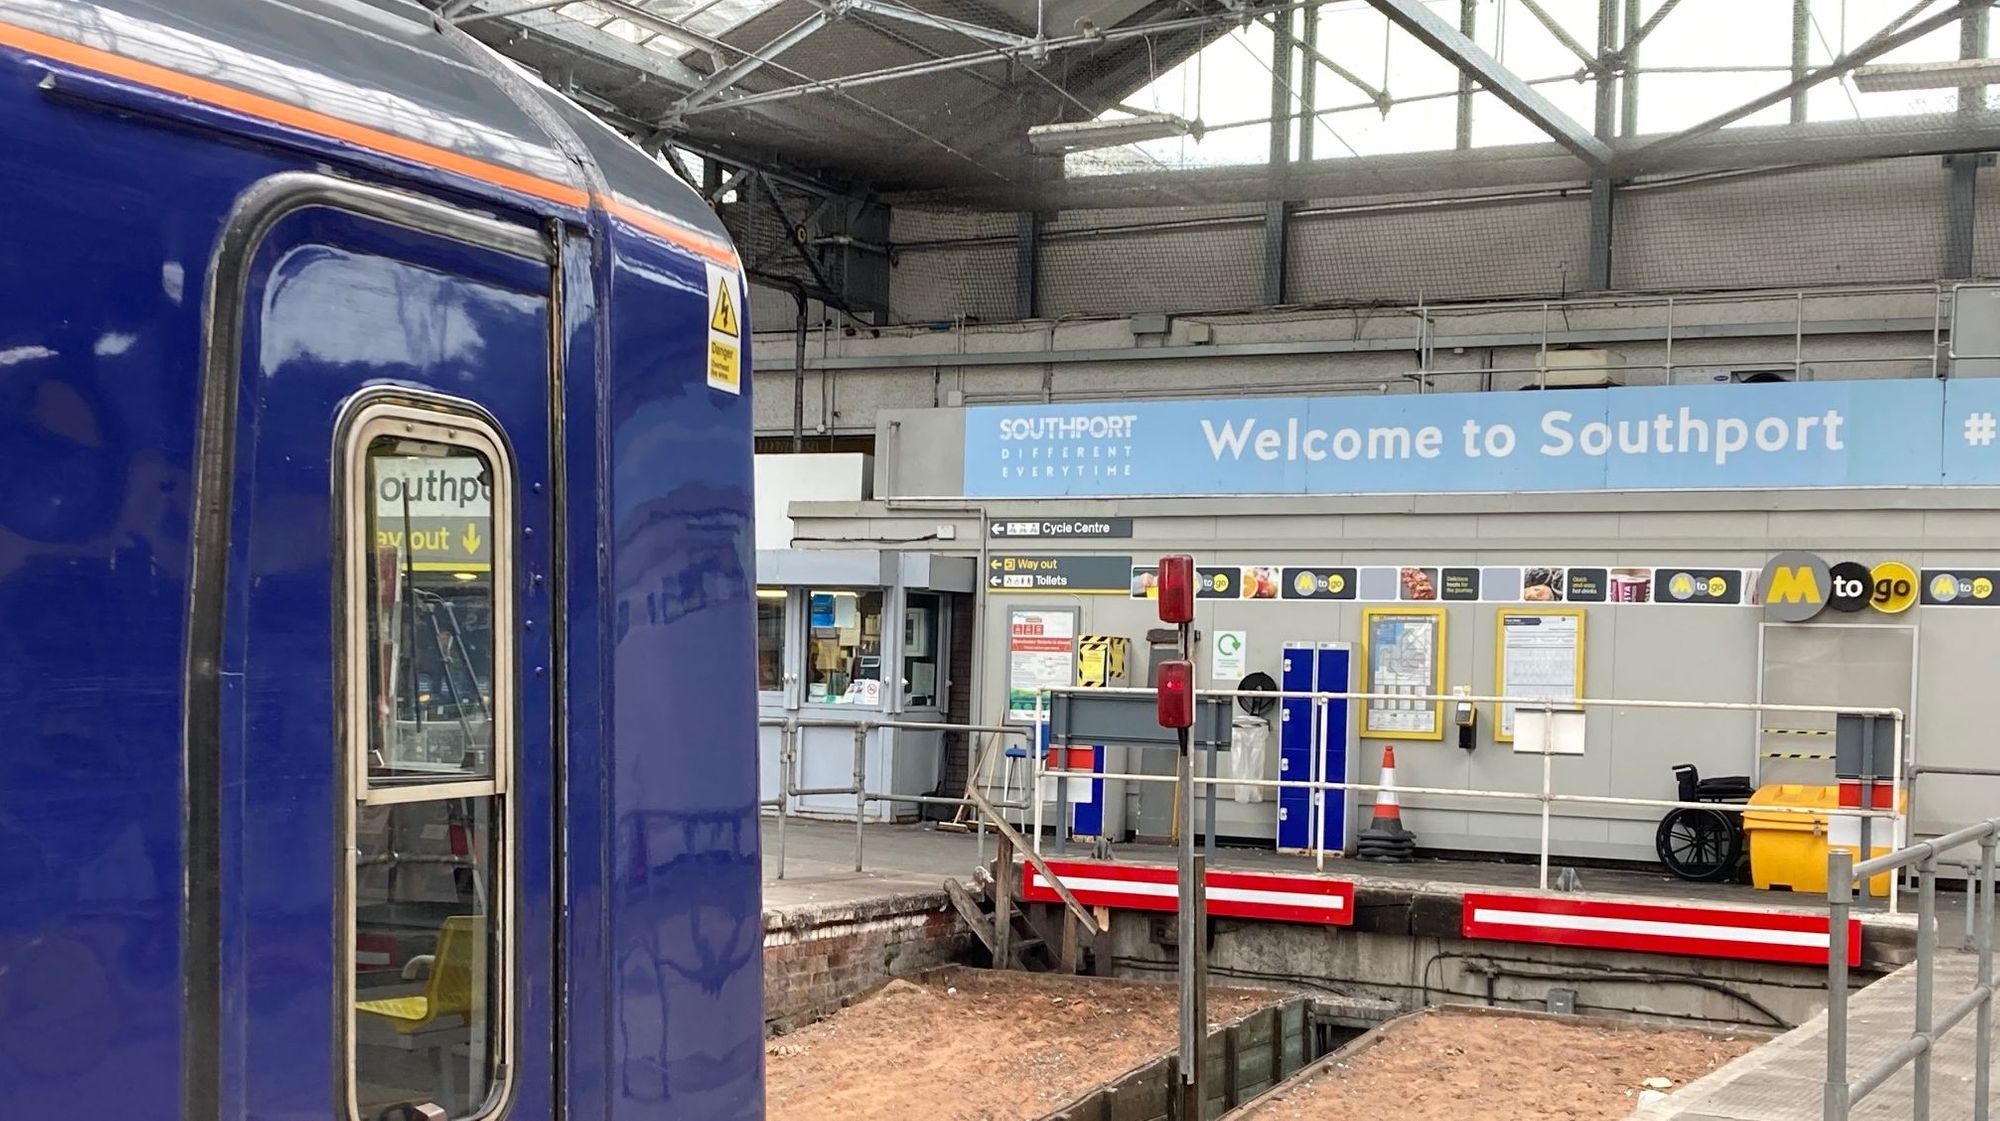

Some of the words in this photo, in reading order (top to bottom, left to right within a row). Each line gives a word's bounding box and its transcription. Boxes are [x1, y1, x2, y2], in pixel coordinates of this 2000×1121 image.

[711, 341, 733, 360] Danger
[1000, 415, 1137, 440] SOUTHPORT
[1201, 418, 1442, 461] Welcome
[1463, 419, 1516, 457] to
[1540, 406, 1844, 465] Southport
[1001, 446, 1132, 460] DIFFERENT
[1001, 465, 1131, 478] EVERYTIME
[1042, 522, 1072, 535] Cycle
[1074, 522, 1110, 534] Centre
[410, 527, 449, 550] out
[1018, 559, 1039, 570] Way
[1040, 559, 1057, 569] out
[1036, 575, 1067, 586] Toilets
[1203, 579, 1213, 587] to
[1215, 580, 1227, 590] go
[1318, 579, 1328, 588] to
[1331, 580, 1342, 590] go
[1766, 566, 1822, 604] M
[1834, 575, 1863, 598] to
[1874, 577, 1911, 602] go
[1696, 582, 1707, 591] to
[1711, 583, 1724, 593] go
[1960, 582, 1972, 592] to
[1975, 584, 1990, 594] go
